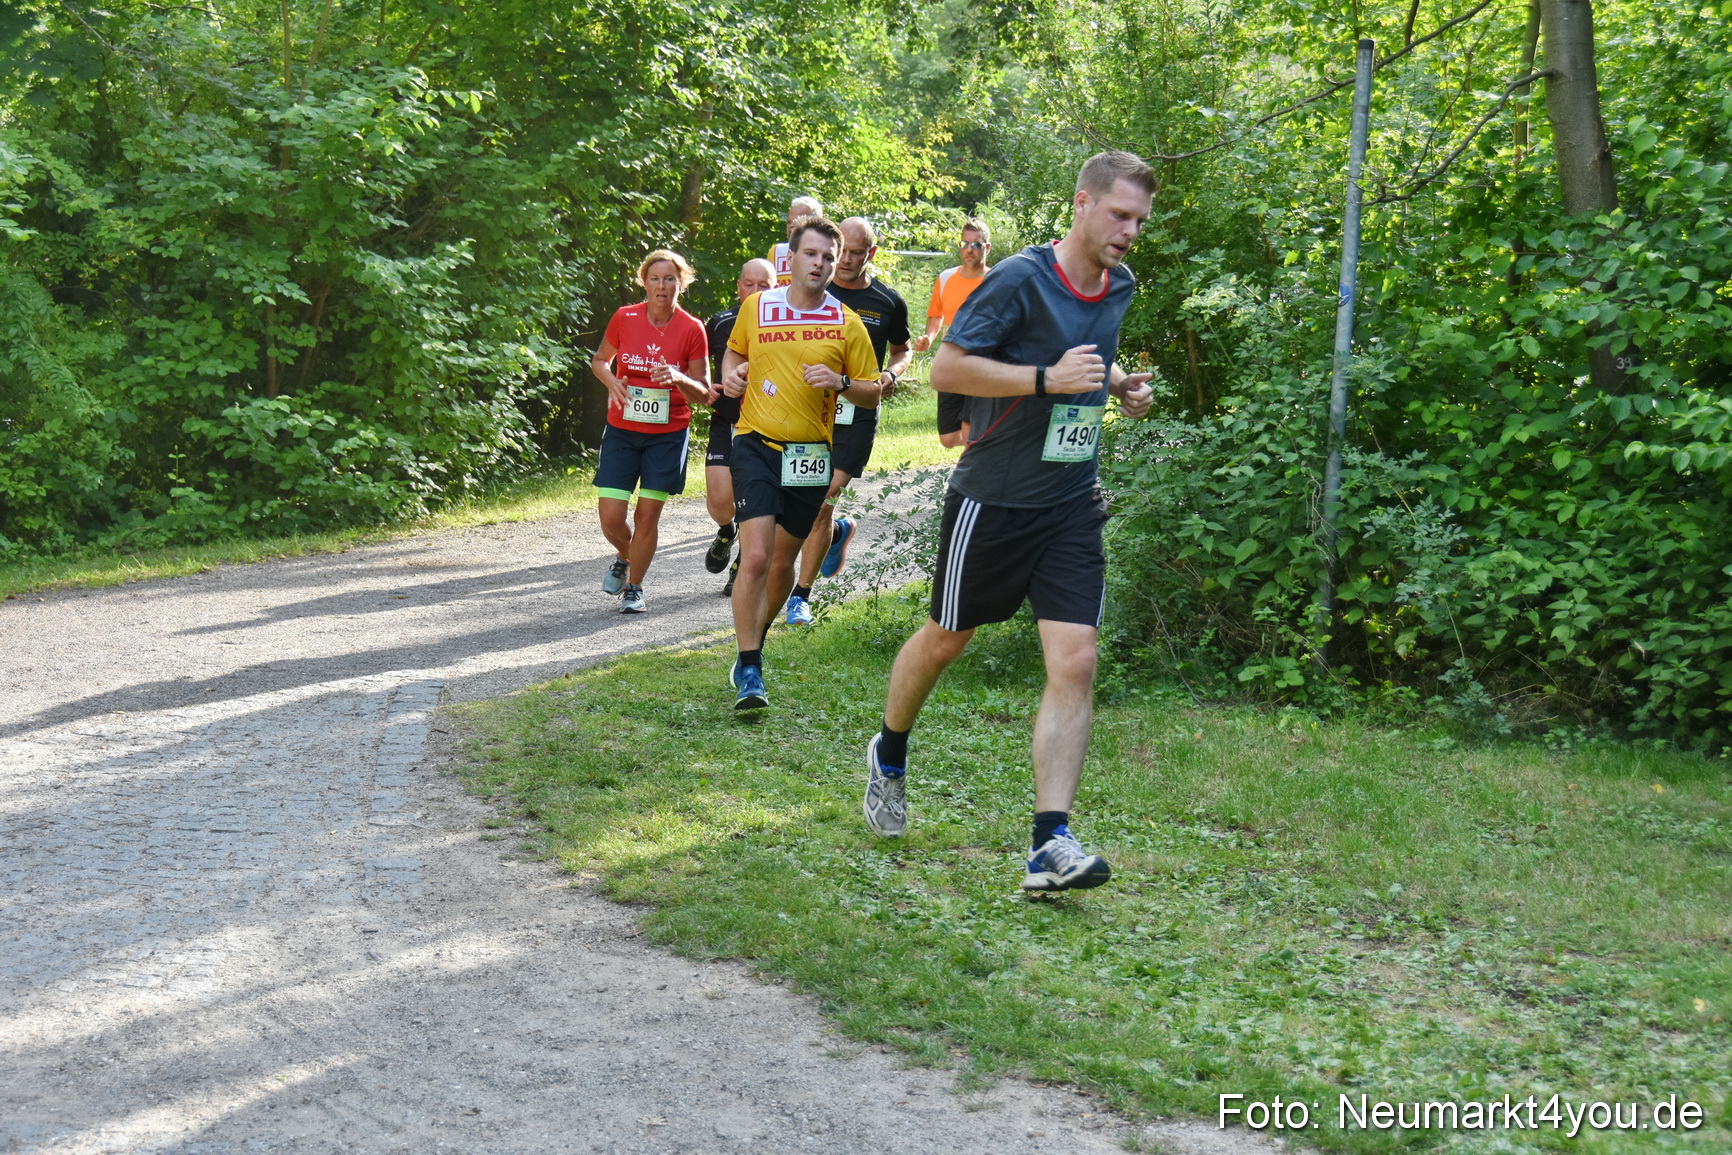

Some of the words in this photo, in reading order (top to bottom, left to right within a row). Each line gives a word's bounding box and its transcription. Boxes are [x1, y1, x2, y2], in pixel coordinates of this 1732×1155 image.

[758, 331, 797, 343] MAX
[802, 327, 846, 341] BÖGL
[622, 353, 644, 365] Echtes
[633, 399, 659, 414] 600
[1057, 425, 1097, 446] 1490
[790, 459, 826, 474] 1549
